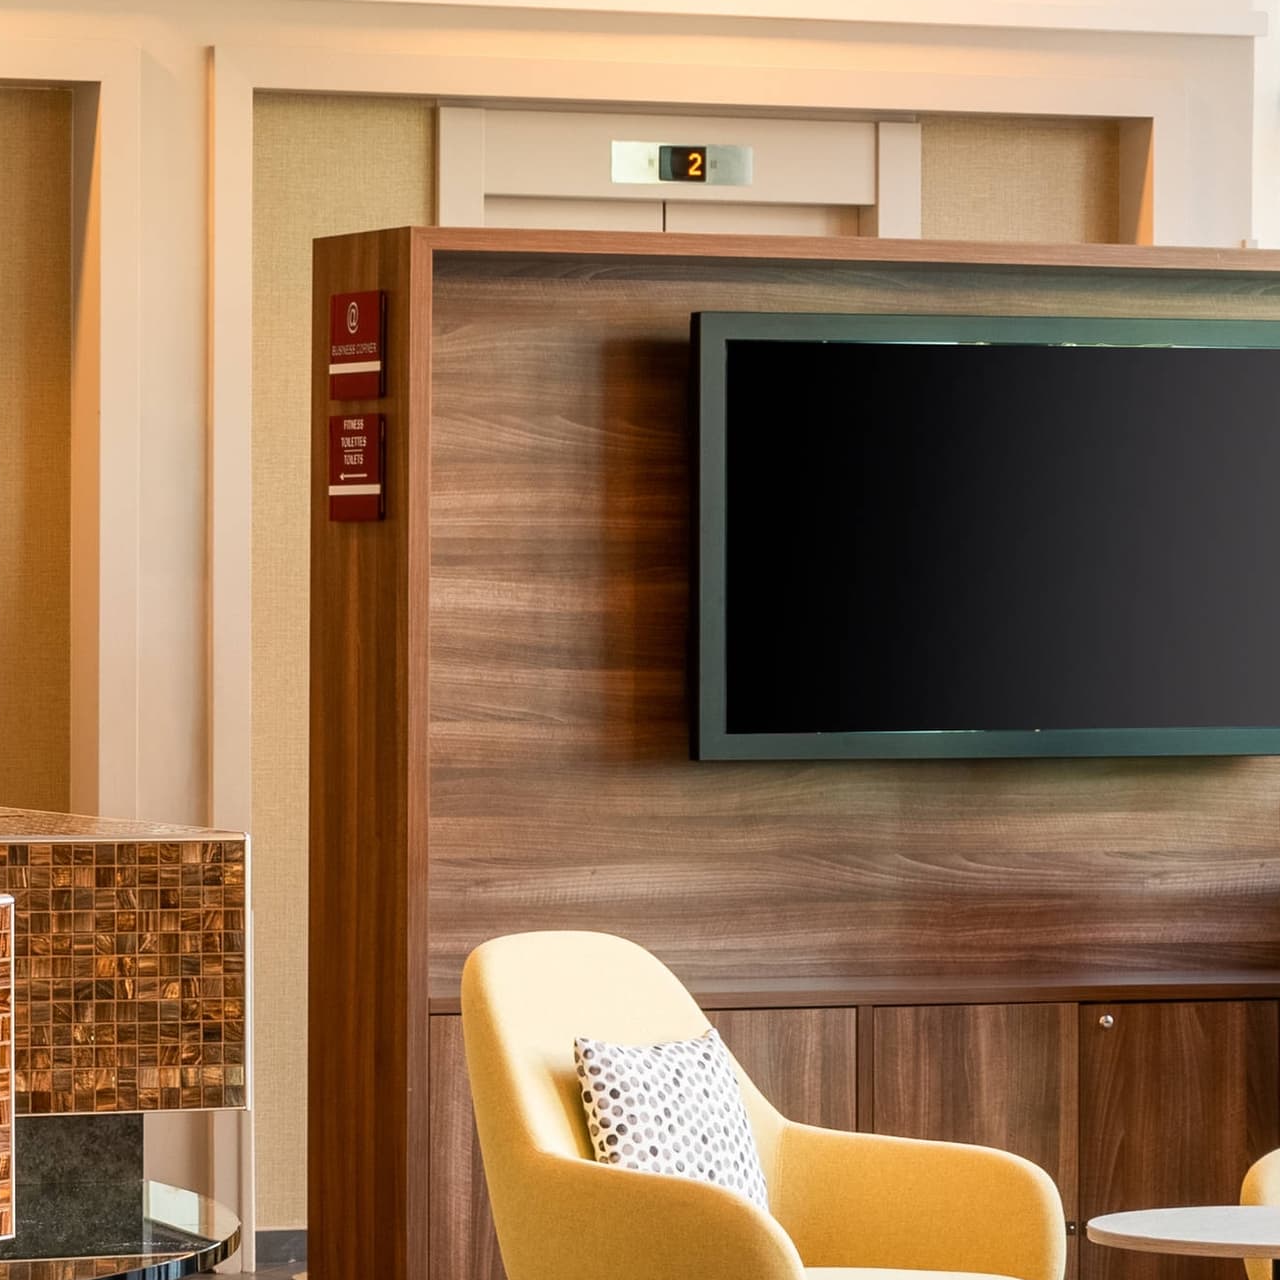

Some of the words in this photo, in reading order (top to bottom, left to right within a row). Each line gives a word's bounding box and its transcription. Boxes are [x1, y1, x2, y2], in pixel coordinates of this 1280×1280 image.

[688, 153, 702, 176] 2
[343, 419, 364, 430] FITNESS
[340, 435, 367, 448] TOILETTES
[344, 454, 364, 465] TOILETS
